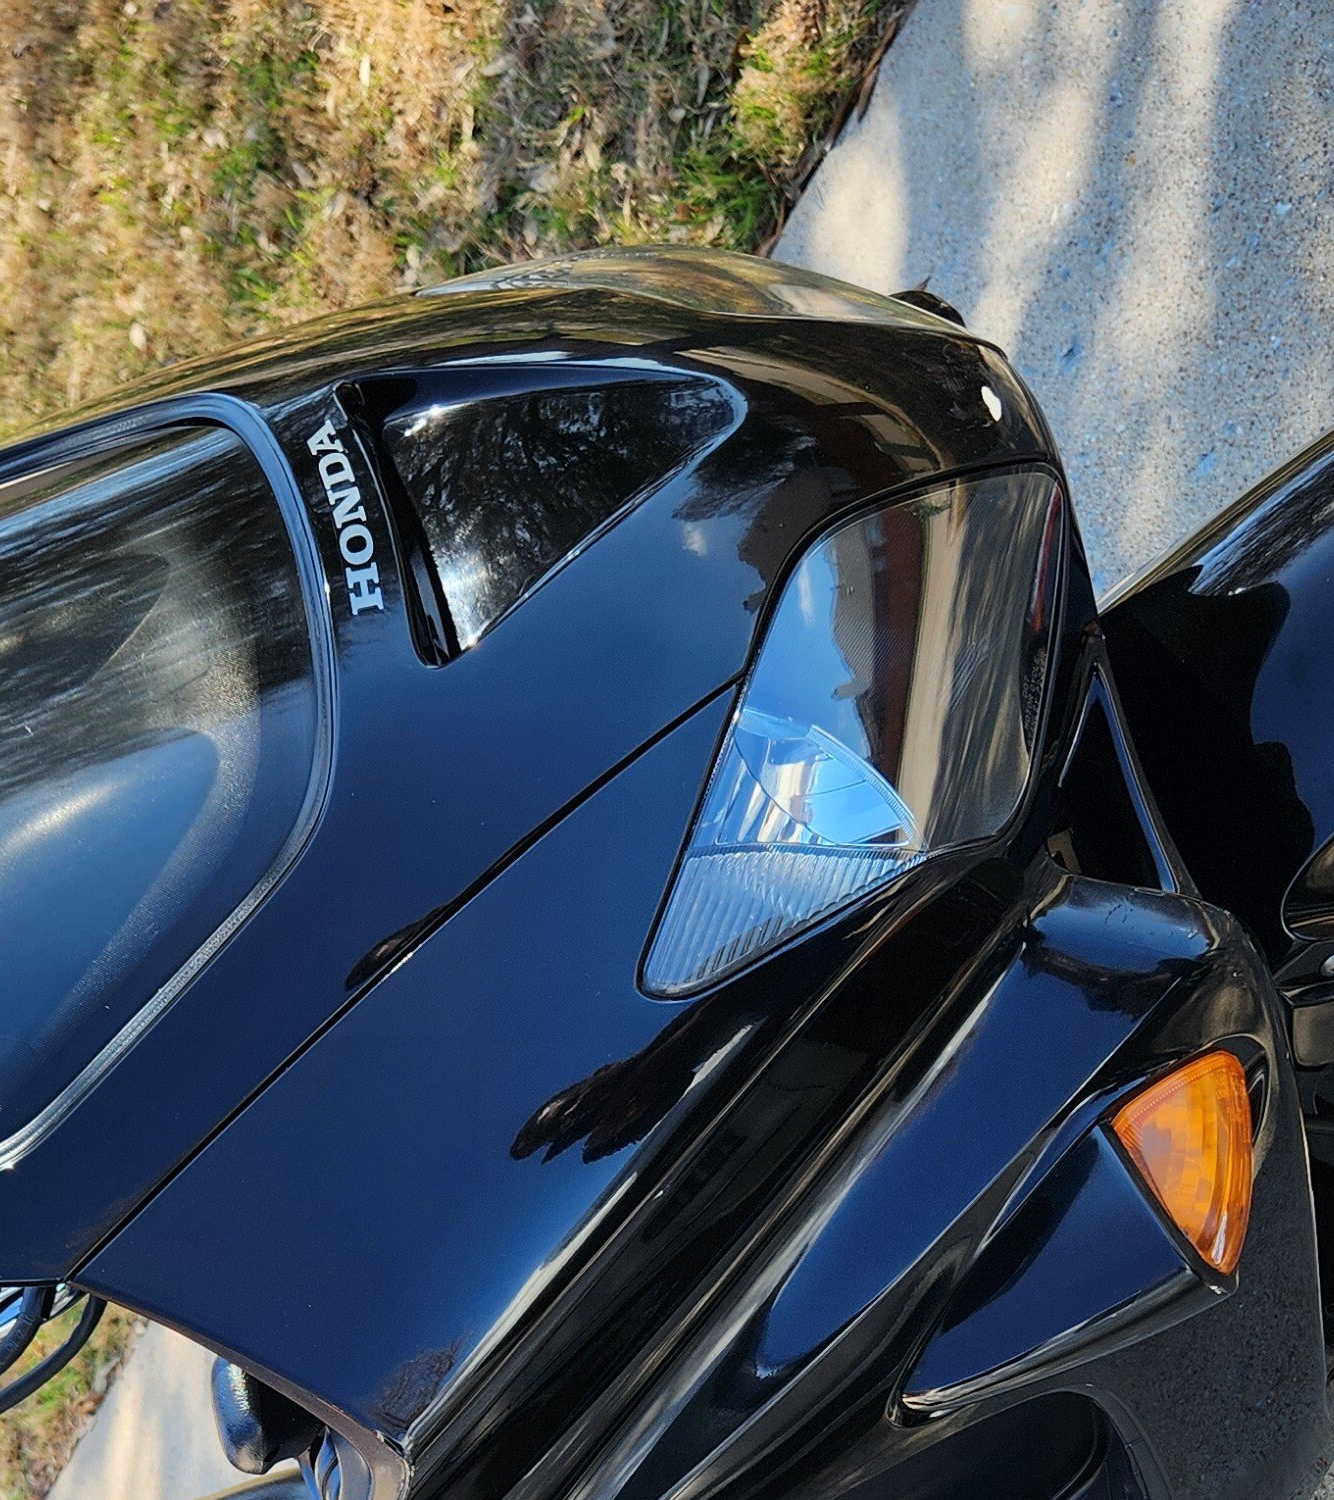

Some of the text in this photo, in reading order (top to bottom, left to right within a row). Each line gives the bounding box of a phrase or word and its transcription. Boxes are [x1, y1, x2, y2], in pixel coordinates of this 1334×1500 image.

[305, 419, 386, 617] HONDA
[1021, 674, 1030, 699] DOT
[1023, 693, 1034, 732] MOTOR
